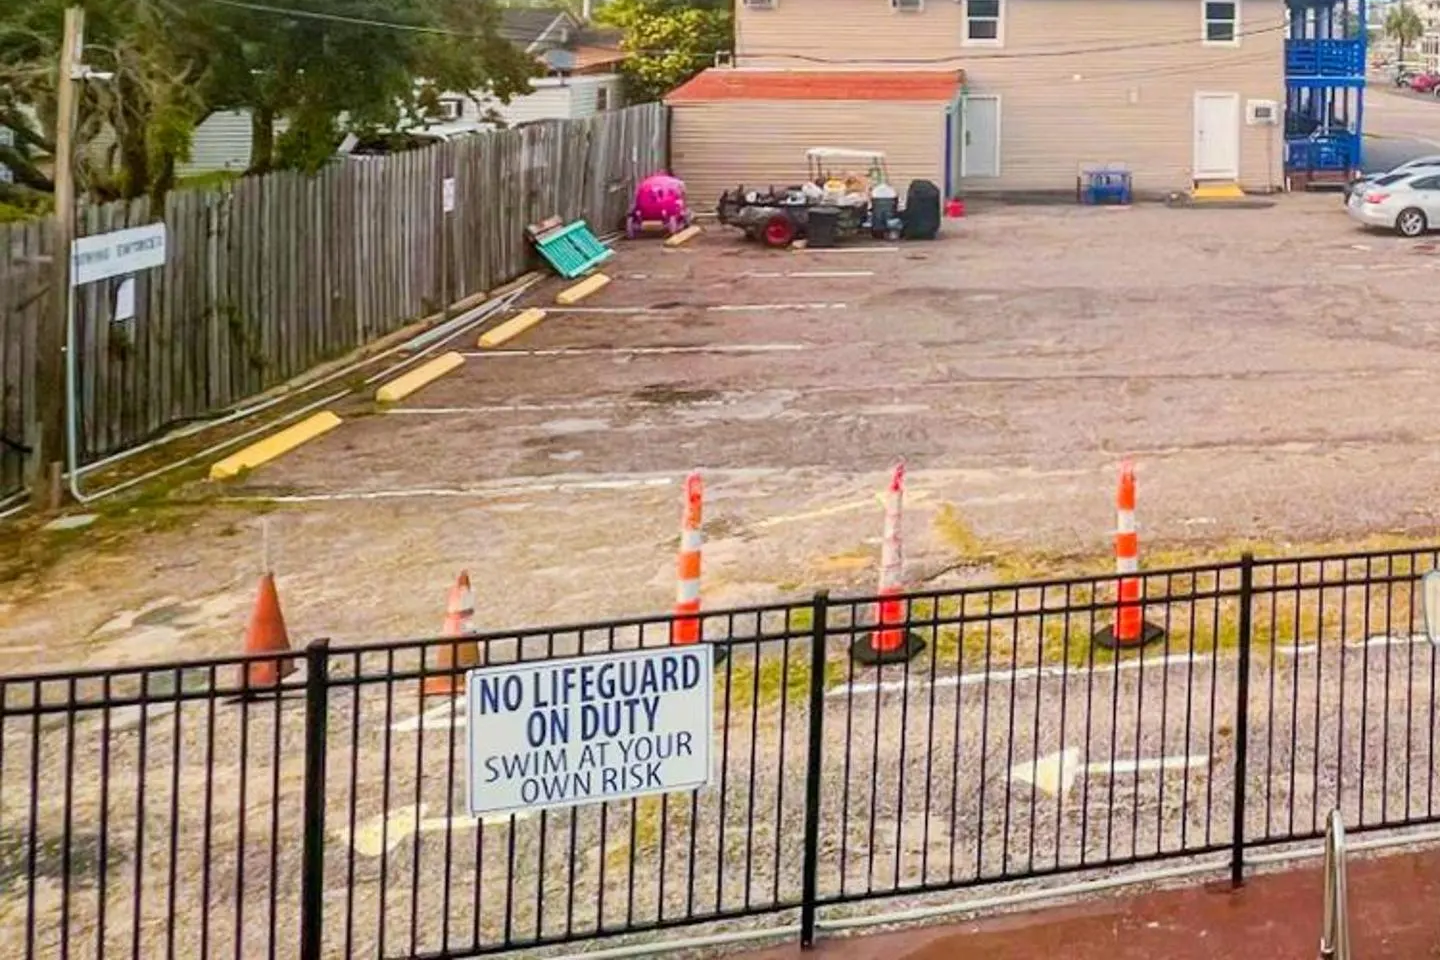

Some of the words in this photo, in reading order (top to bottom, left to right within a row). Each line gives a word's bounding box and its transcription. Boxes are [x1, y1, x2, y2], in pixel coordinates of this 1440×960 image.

[480, 676, 523, 715] NO
[533, 654, 700, 708] LIFEGUARD
[527, 707, 569, 748] ON
[581, 695, 660, 741] DUTY
[484, 748, 568, 783] SWIM
[578, 742, 613, 770] AT
[618, 730, 693, 764] YOUR
[521, 771, 591, 804] OWN
[602, 762, 662, 794] RISK
